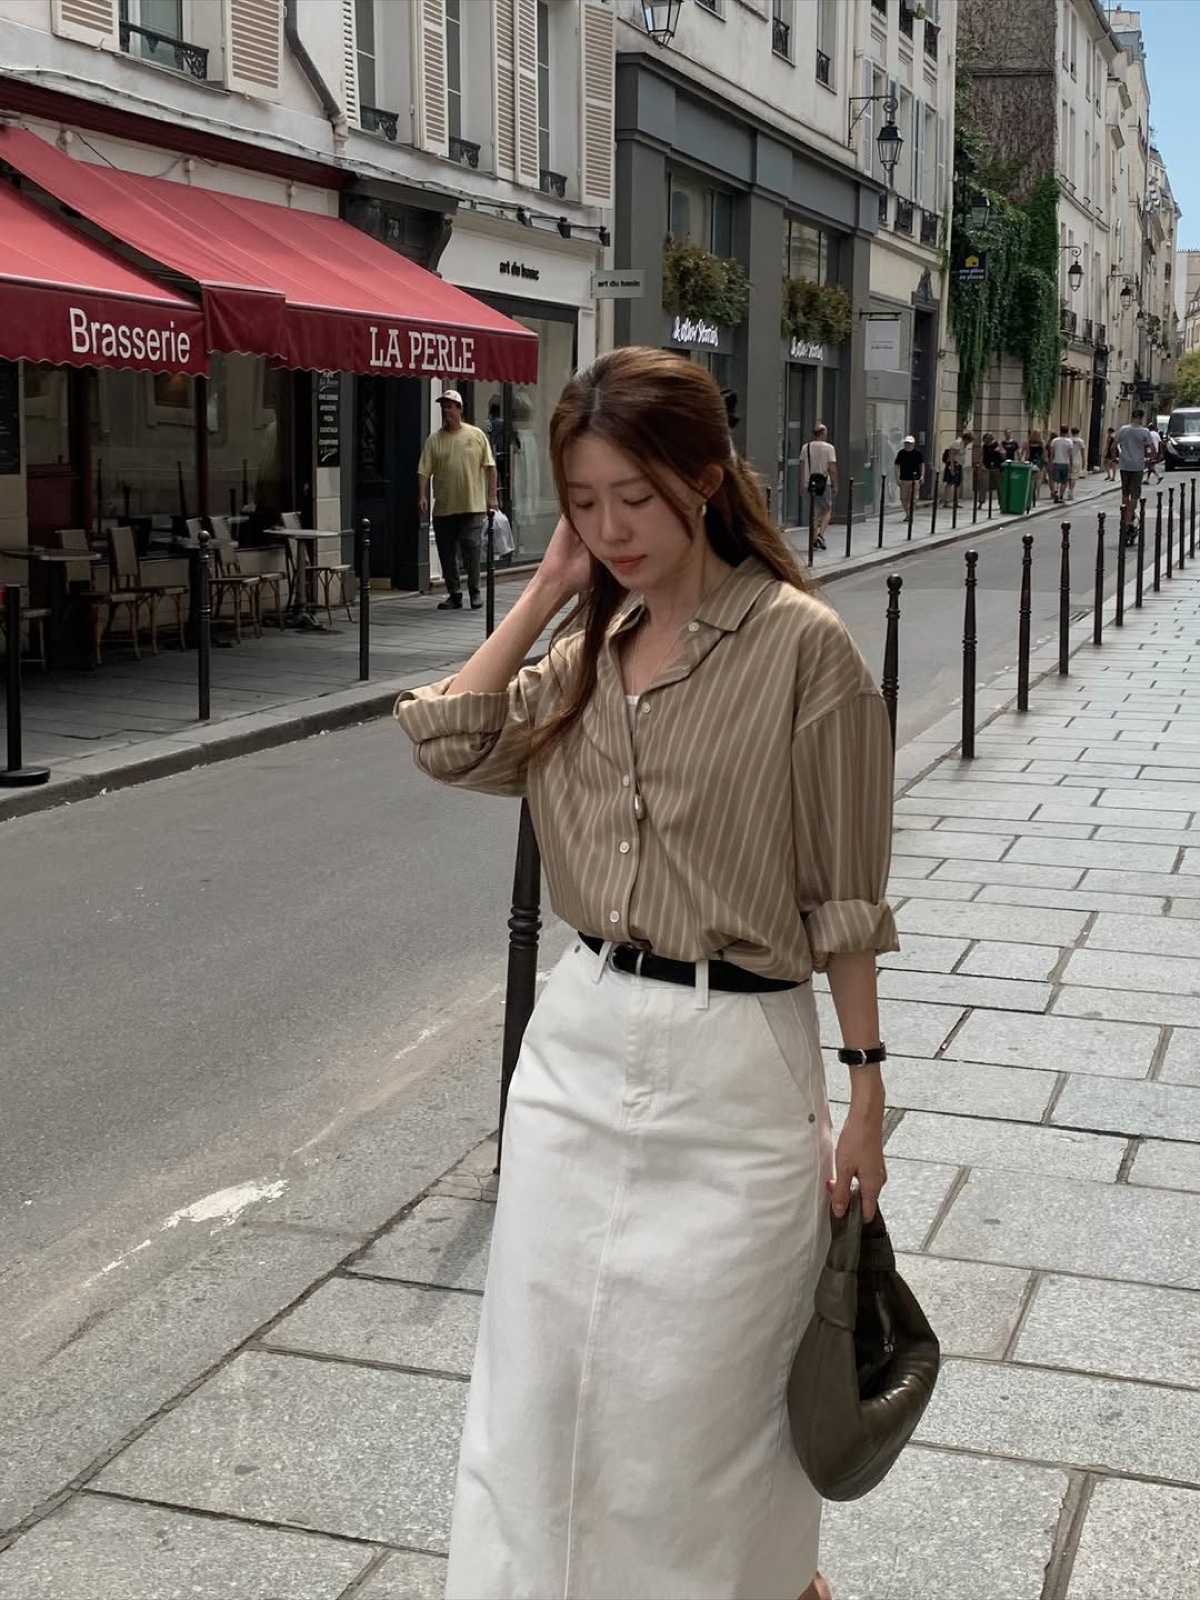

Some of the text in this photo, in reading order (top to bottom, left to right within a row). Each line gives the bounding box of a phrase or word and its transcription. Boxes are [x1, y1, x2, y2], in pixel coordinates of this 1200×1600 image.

[69, 307, 190, 363] Brasserie
[369, 326, 476, 374] LA PERLE
